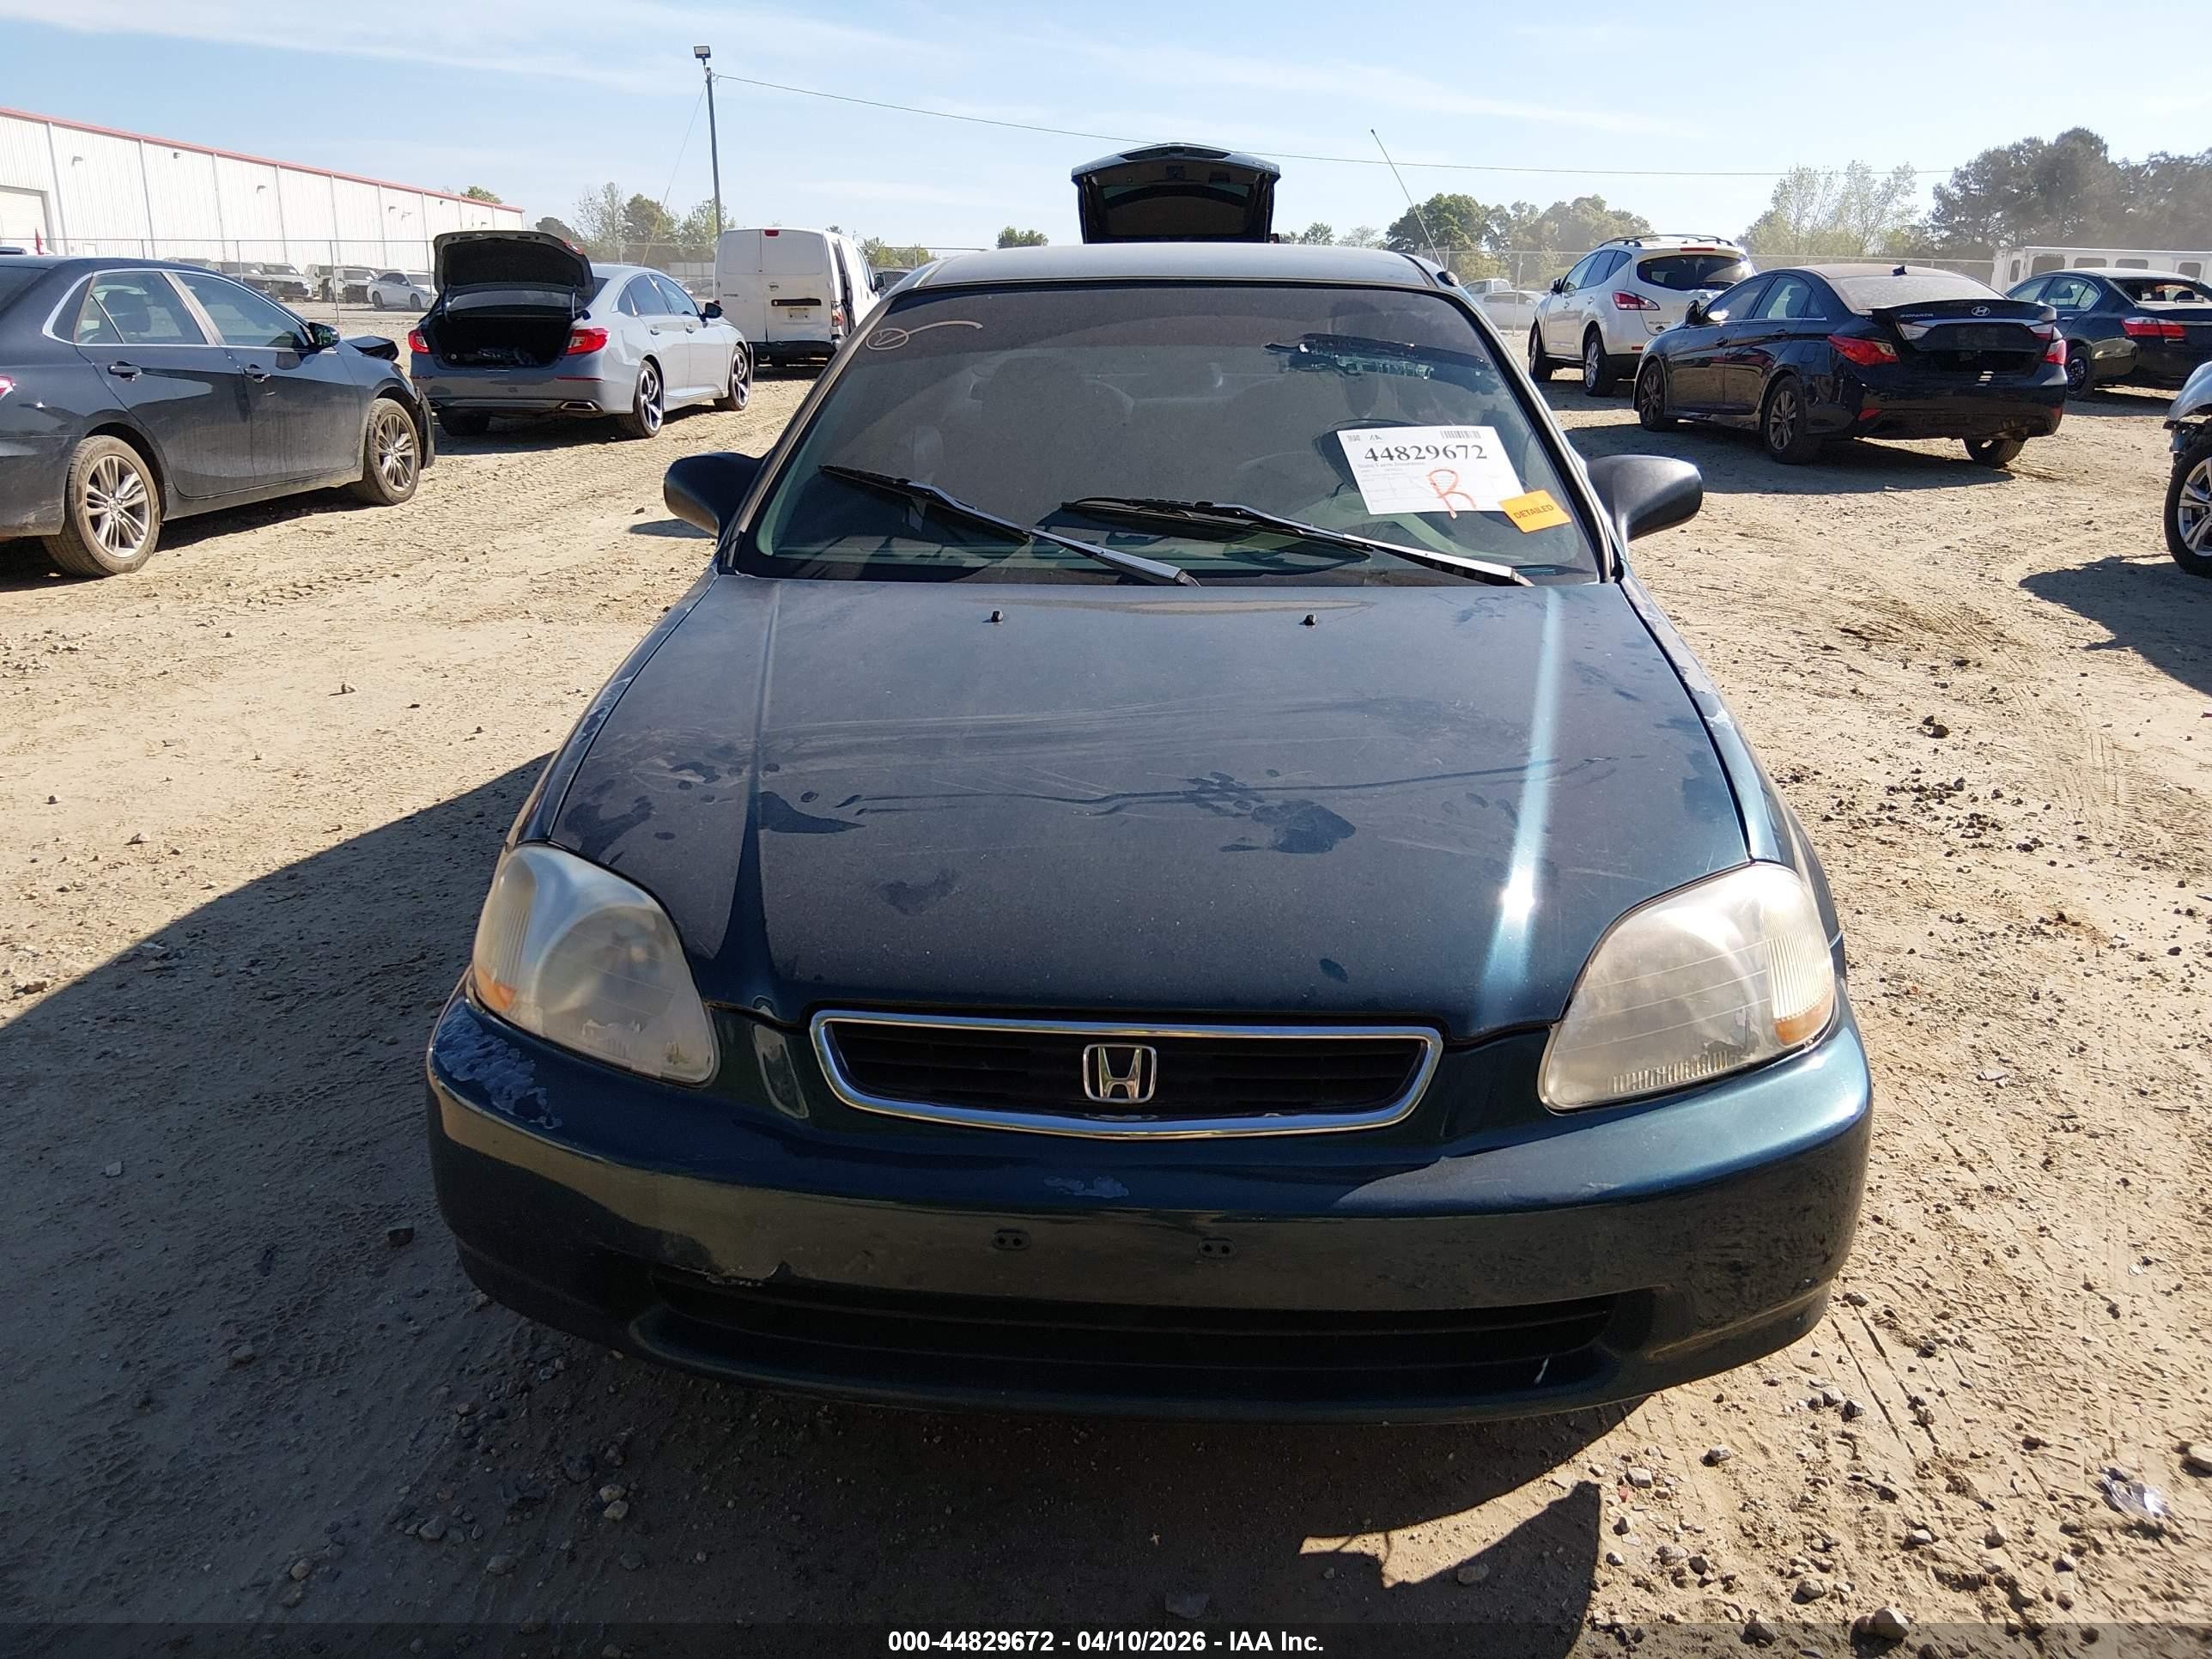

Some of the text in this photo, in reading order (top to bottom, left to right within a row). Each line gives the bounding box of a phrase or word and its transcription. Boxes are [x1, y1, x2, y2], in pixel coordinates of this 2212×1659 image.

[1364, 445, 1487, 461] 44829672
[1426, 469, 1478, 519] R
[1513, 504, 1554, 519] DETAILED
